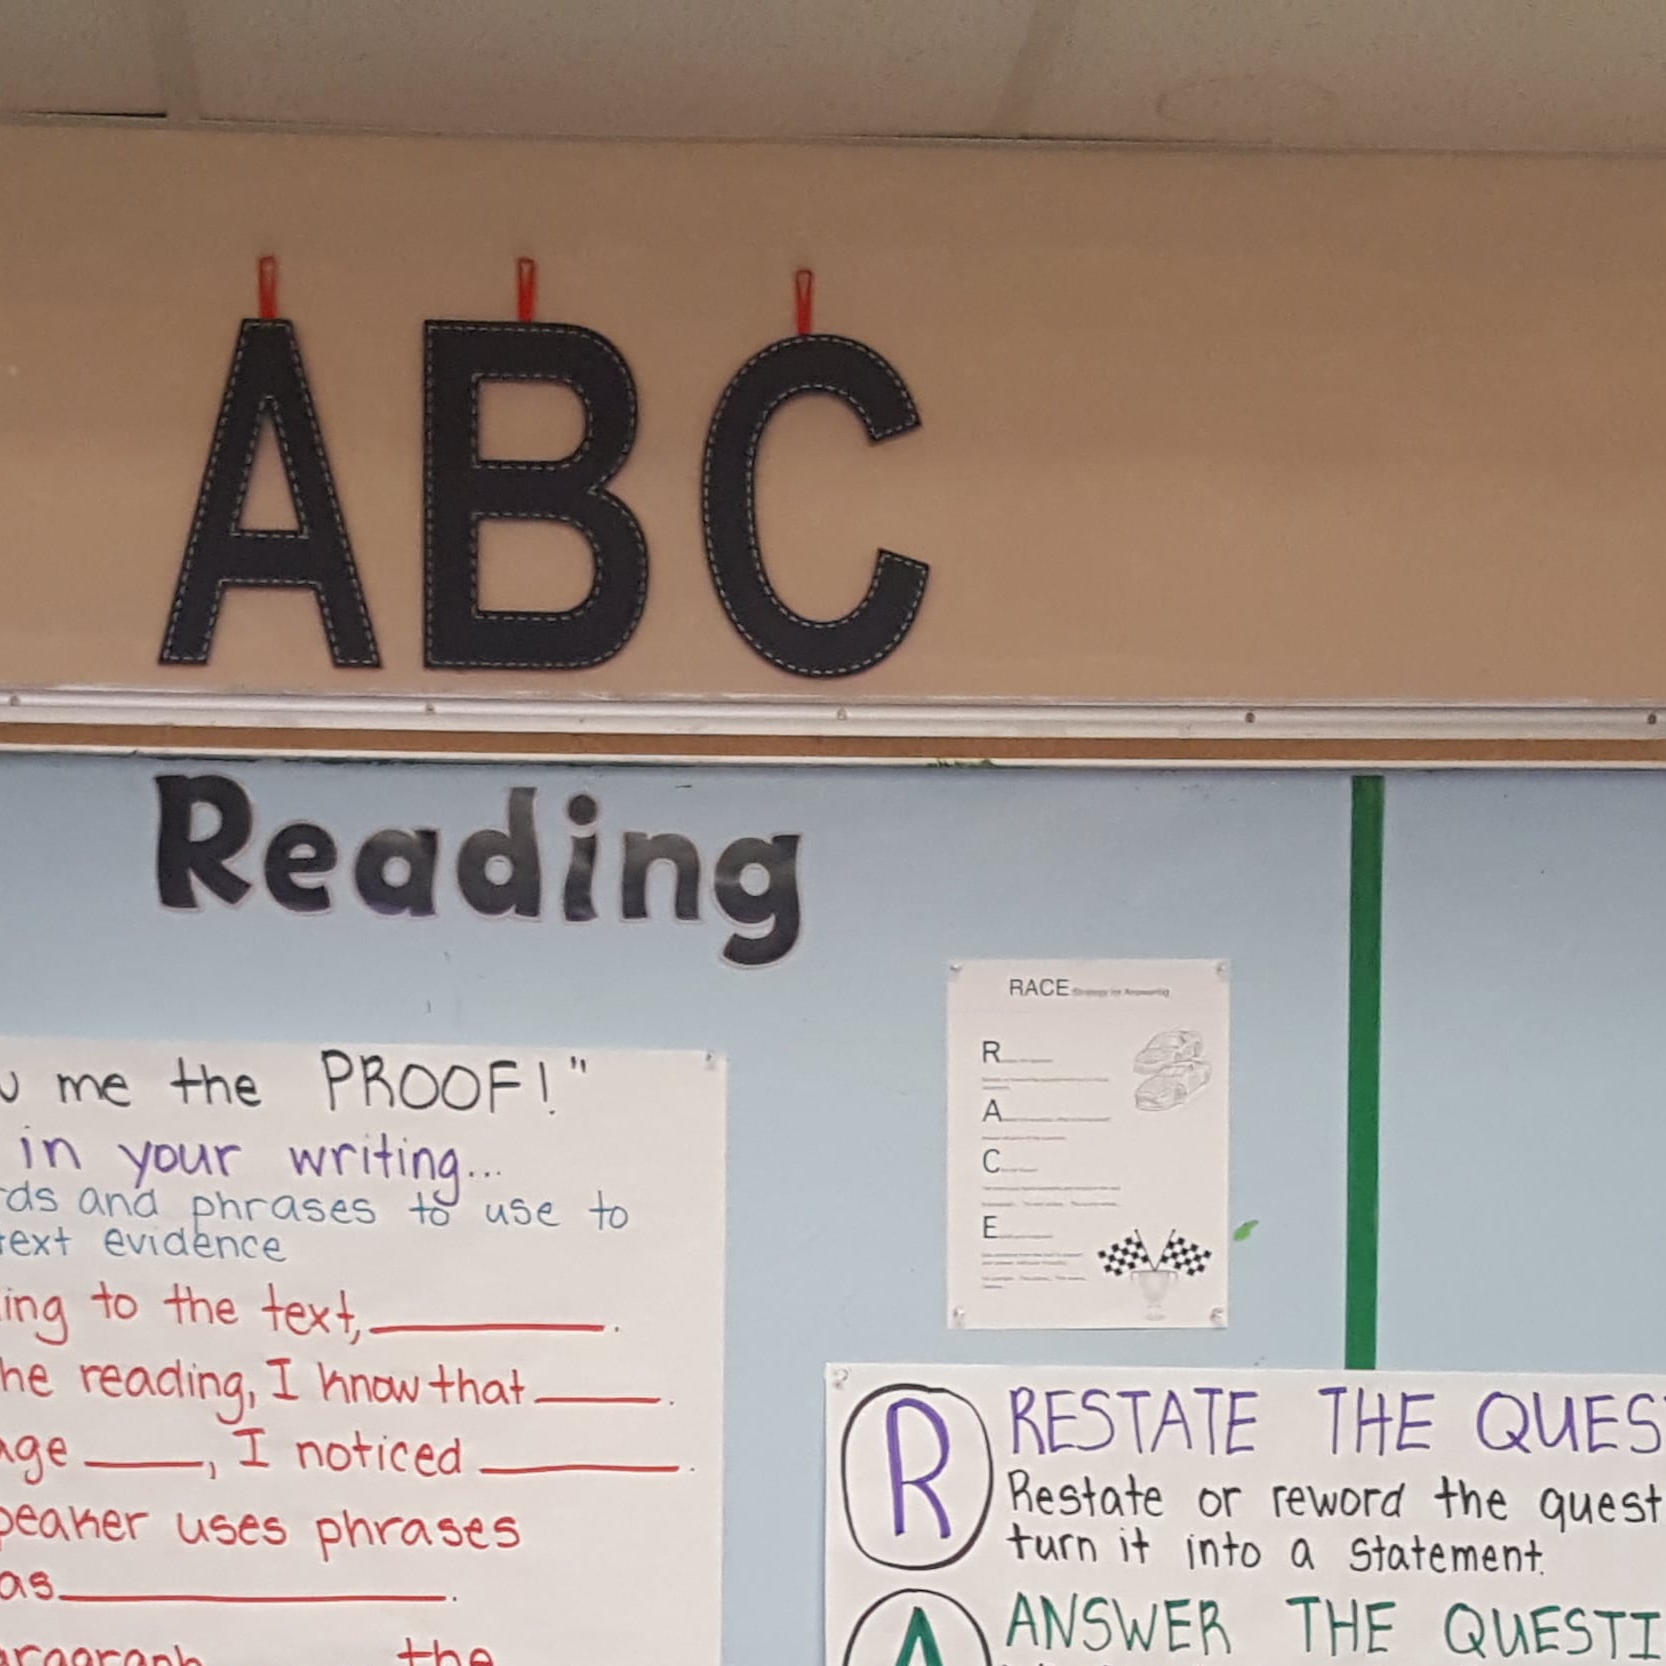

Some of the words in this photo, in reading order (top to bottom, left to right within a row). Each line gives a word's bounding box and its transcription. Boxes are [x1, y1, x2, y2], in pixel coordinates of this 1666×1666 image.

[155, 773, 801, 969] Reading
[1009, 979, 1069, 997] RACE
[982, 1041, 1001, 1063] R
[55, 1072, 132, 1108] me
[169, 1056, 262, 1108] the
[320, 1048, 587, 1116] PROOF!"
[983, 1099, 1002, 1121] A
[19, 1124, 82, 1170] in
[117, 1139, 243, 1190] your
[287, 1131, 502, 1208] writing...
[983, 1149, 1001, 1173] C
[78, 1186, 159, 1219] and
[192, 1191, 377, 1233] phrases
[408, 1191, 451, 1227] to
[485, 1197, 561, 1228] use
[588, 1189, 629, 1231] to
[983, 1216, 998, 1238] E
[103, 1226, 287, 1263] evidence
[1008, 1385, 1260, 1457] RESTATE
[1316, 1385, 1436, 1457] THE
[882, 1397, 954, 1540] R
[1006, 1468, 1164, 1518] Restate
[1197, 1486, 1243, 1518] or
[1271, 1481, 1406, 1519] reword
[1433, 1474, 1509, 1522] the
[1005, 1591, 1232, 1657] ANSWER
[1284, 1595, 1397, 1658] THE
